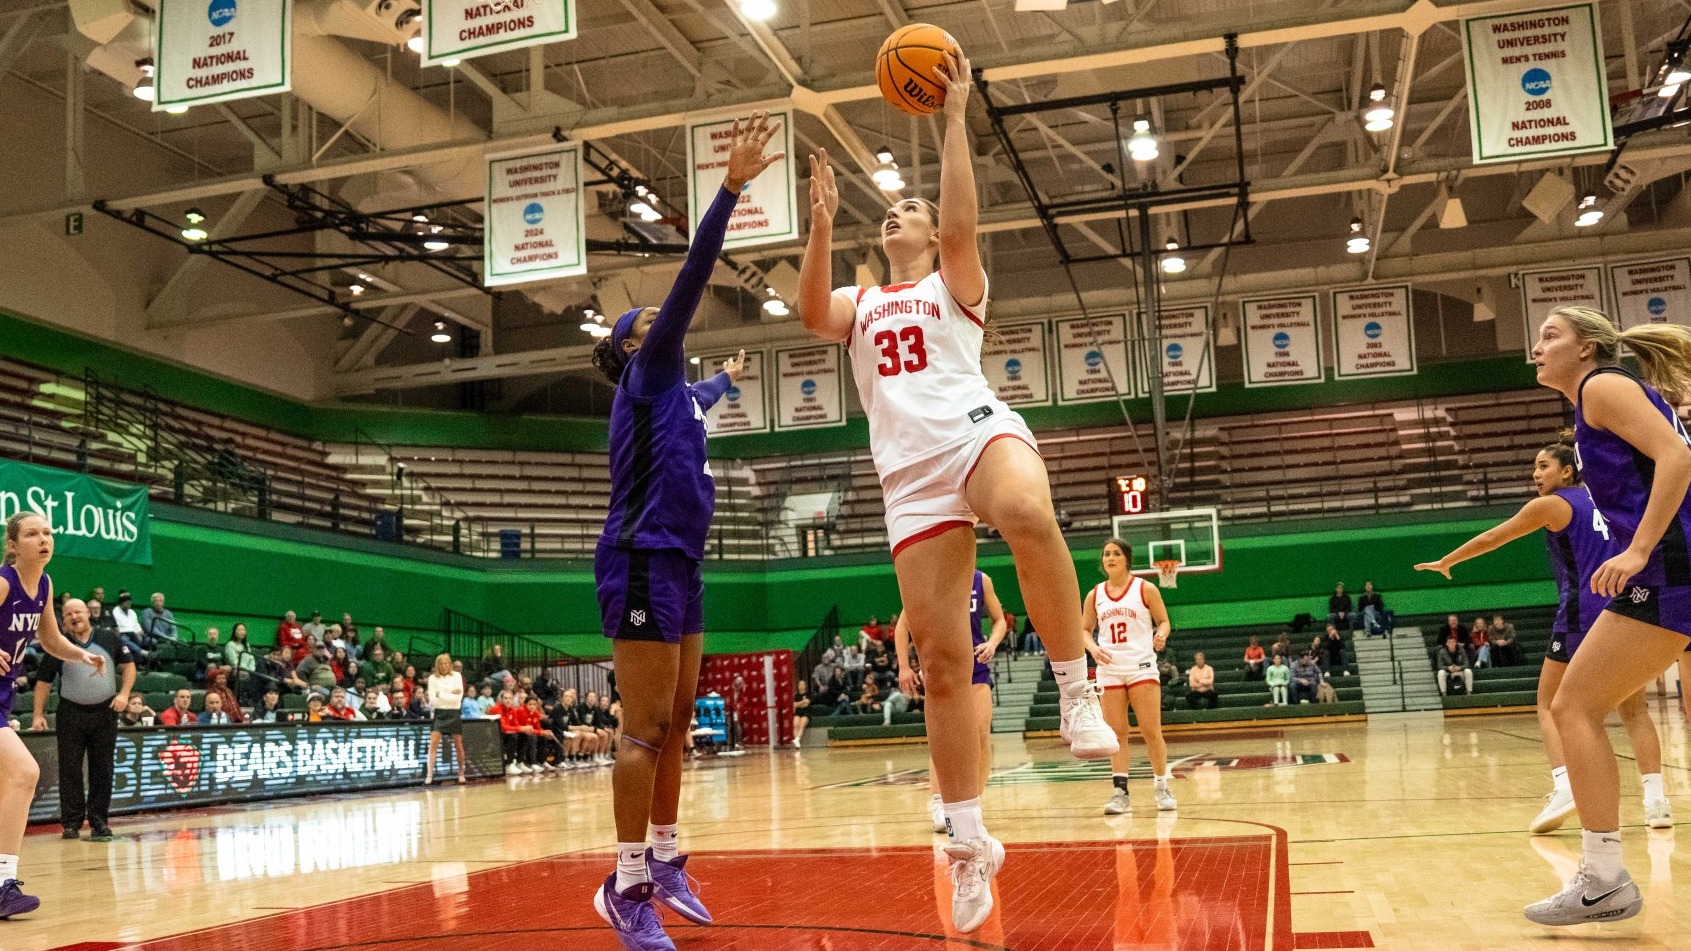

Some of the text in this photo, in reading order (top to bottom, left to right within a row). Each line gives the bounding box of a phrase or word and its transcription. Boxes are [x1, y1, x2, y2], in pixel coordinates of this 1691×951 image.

[211, 7, 237, 20] NCAA
[459, 15, 534, 42] CHAMPIONS
[1491, 16, 1570, 34] WASHINGTON
[208, 32, 235, 48] 2017
[1497, 32, 1567, 49] UNIVERSITY
[192, 49, 249, 69] NATIONAL
[1501, 49, 1566, 65] MEN'S TENNIS
[186, 67, 254, 89] CHAMPIONS
[1525, 80, 1551, 90] NCAA
[903, 77, 945, 109] Wilso
[1524, 98, 1552, 111] 2008
[1511, 116, 1570, 131] NATIONAL
[1508, 131, 1577, 148] CHAMPIONS
[506, 161, 560, 176] WASHINGTON
[508, 174, 558, 188] UNIVERSITY
[524, 228, 544, 238] 2024
[514, 239, 554, 252] NATIONAL
[510, 251, 558, 265] CHAMPIONS
[1627, 264, 1676, 276] WASHINGTON
[1538, 272, 1585, 283] WASHINGTON
[1631, 274, 1674, 285] UNIVERSITY
[1541, 283, 1584, 293] UNIVERSITY
[1650, 284, 1686, 293] VOLLEYBALL
[1349, 292, 1394, 301] WASHINGTON
[1256, 302, 1302, 310] WASHINGTON
[1351, 301, 1392, 310] UNIVERSITY
[860, 299, 941, 336] WASHINGTON
[1260, 311, 1300, 320] UNIVERSITY
[874, 325, 928, 377] 33
[1357, 351, 1391, 359] NATIONAL
[1355, 361, 1396, 370] CHAMPIONS
[1264, 370, 1304, 378] CHAMPIONS
[1078, 378, 1110, 386] NATIONAL
[1124, 490, 1142, 512] 10
[26, 486, 64, 534] St.
[64, 490, 138, 542] Louis
[1592, 508, 1610, 540] 4
[1101, 607, 1136, 622] WASHINGTON
[8, 613, 41, 632] NYU
[1110, 622, 1127, 644] 12
[215, 741, 292, 782] BEARS
[297, 738, 420, 776] BASKETBALL
